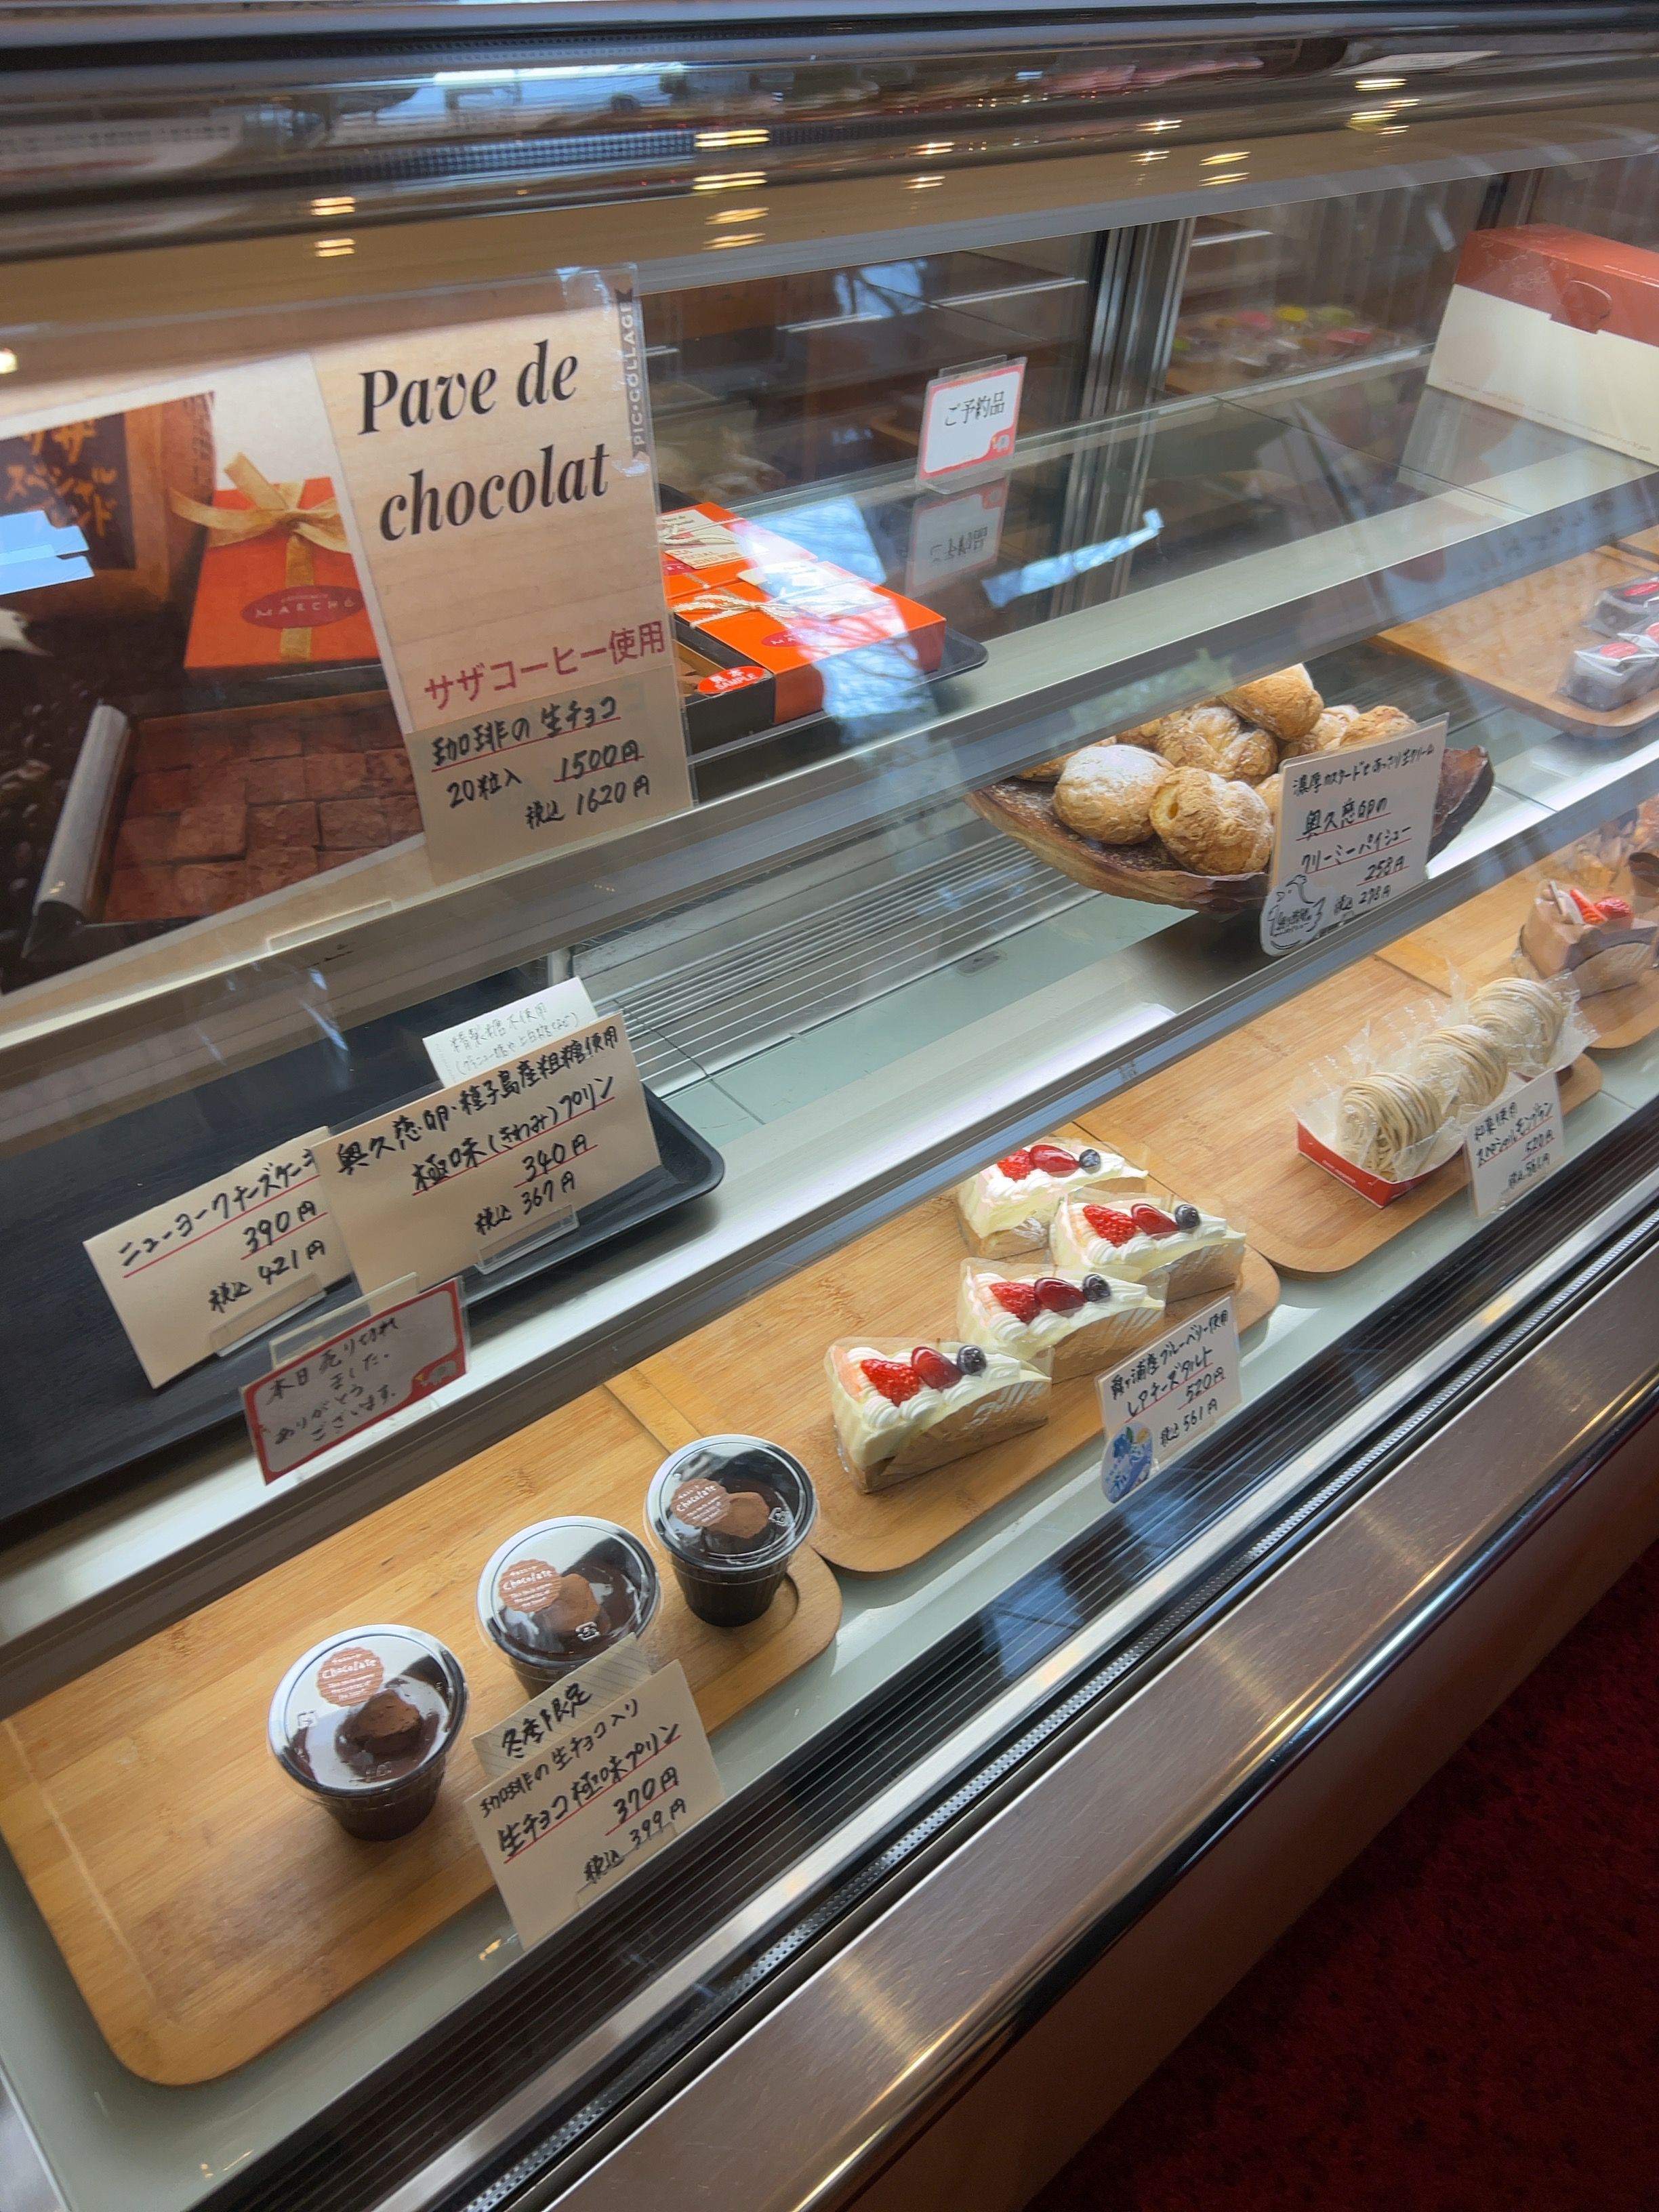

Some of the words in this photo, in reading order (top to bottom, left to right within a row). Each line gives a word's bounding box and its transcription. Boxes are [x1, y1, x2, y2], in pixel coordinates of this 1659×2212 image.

[358, 367, 497, 436] Pave
[517, 339, 579, 408] de
[944, 390, 1005, 427] ご予約品
[380, 443, 610, 541] chocolat
[424, 620, 665, 710] サザコーヒー使用
[714, 673, 758, 690] SAMPLE
[447, 767, 523, 809] 20粒入
[560, 739, 640, 781] 1500円
[523, 1133, 589, 1184] 340円
[241, 1200, 318, 1255] 390円
[613, 1766, 680, 1824] 370円
